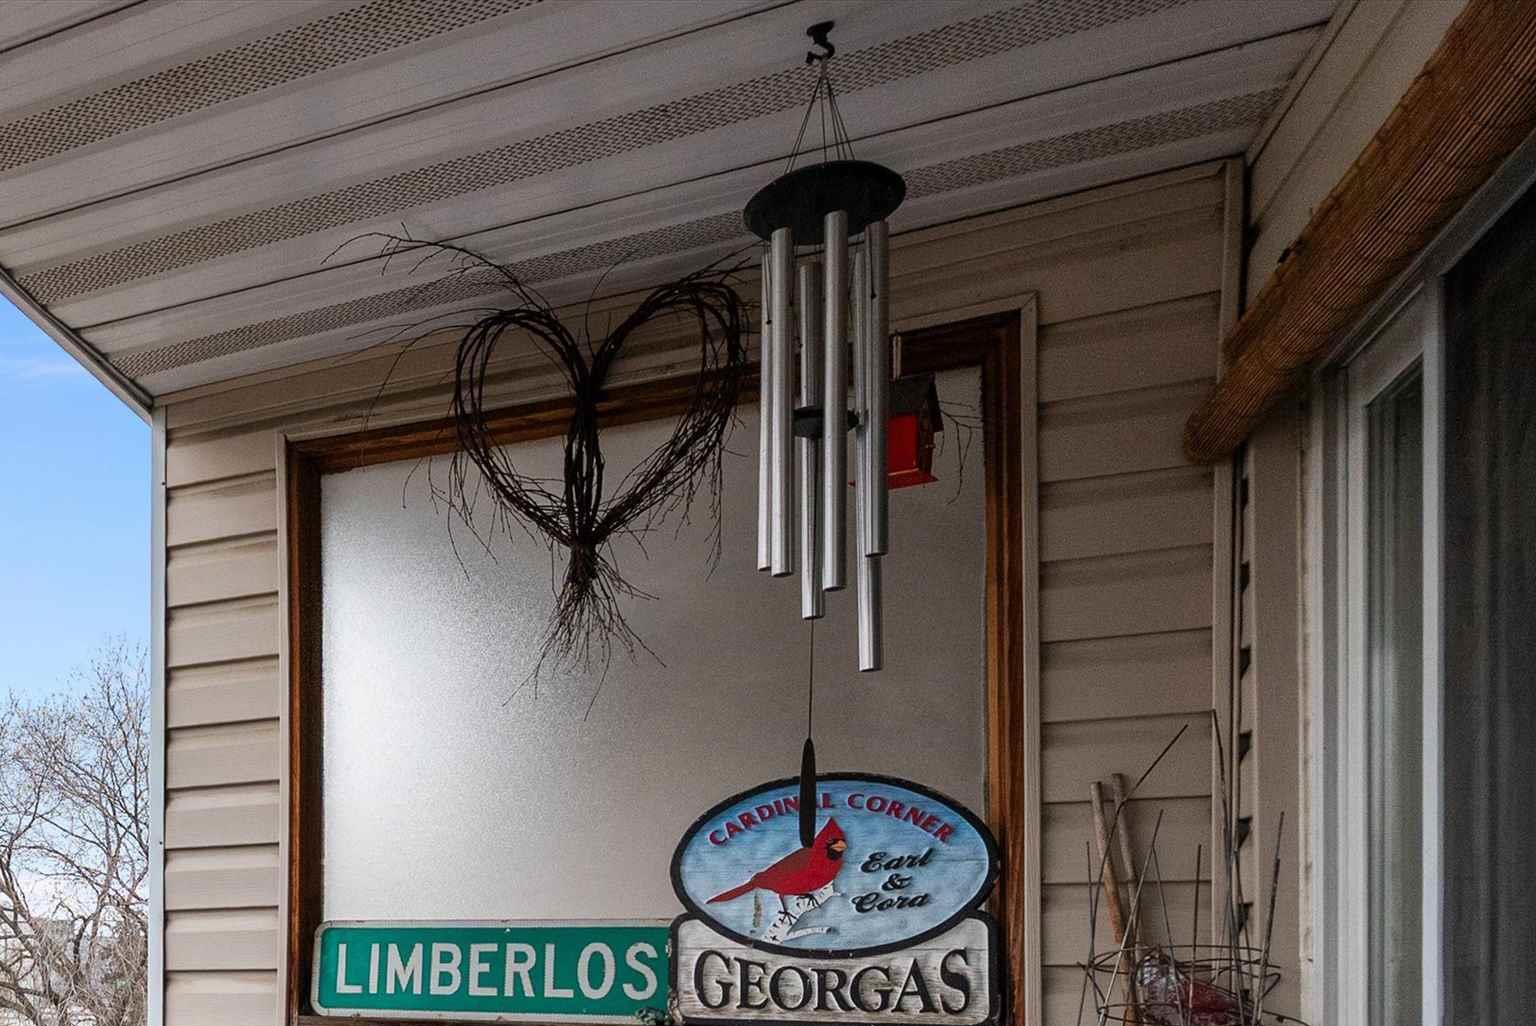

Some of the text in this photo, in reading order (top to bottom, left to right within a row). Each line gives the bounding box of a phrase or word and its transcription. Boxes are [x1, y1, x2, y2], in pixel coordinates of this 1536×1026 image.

[709, 793, 955, 846] CARDINL CORNER
[860, 848, 933, 873] Earl
[882, 873, 912, 891] &
[852, 891, 928, 914] Cora
[335, 942, 658, 1001] LIMBERLOS
[693, 949, 971, 1014] GEORGAS
